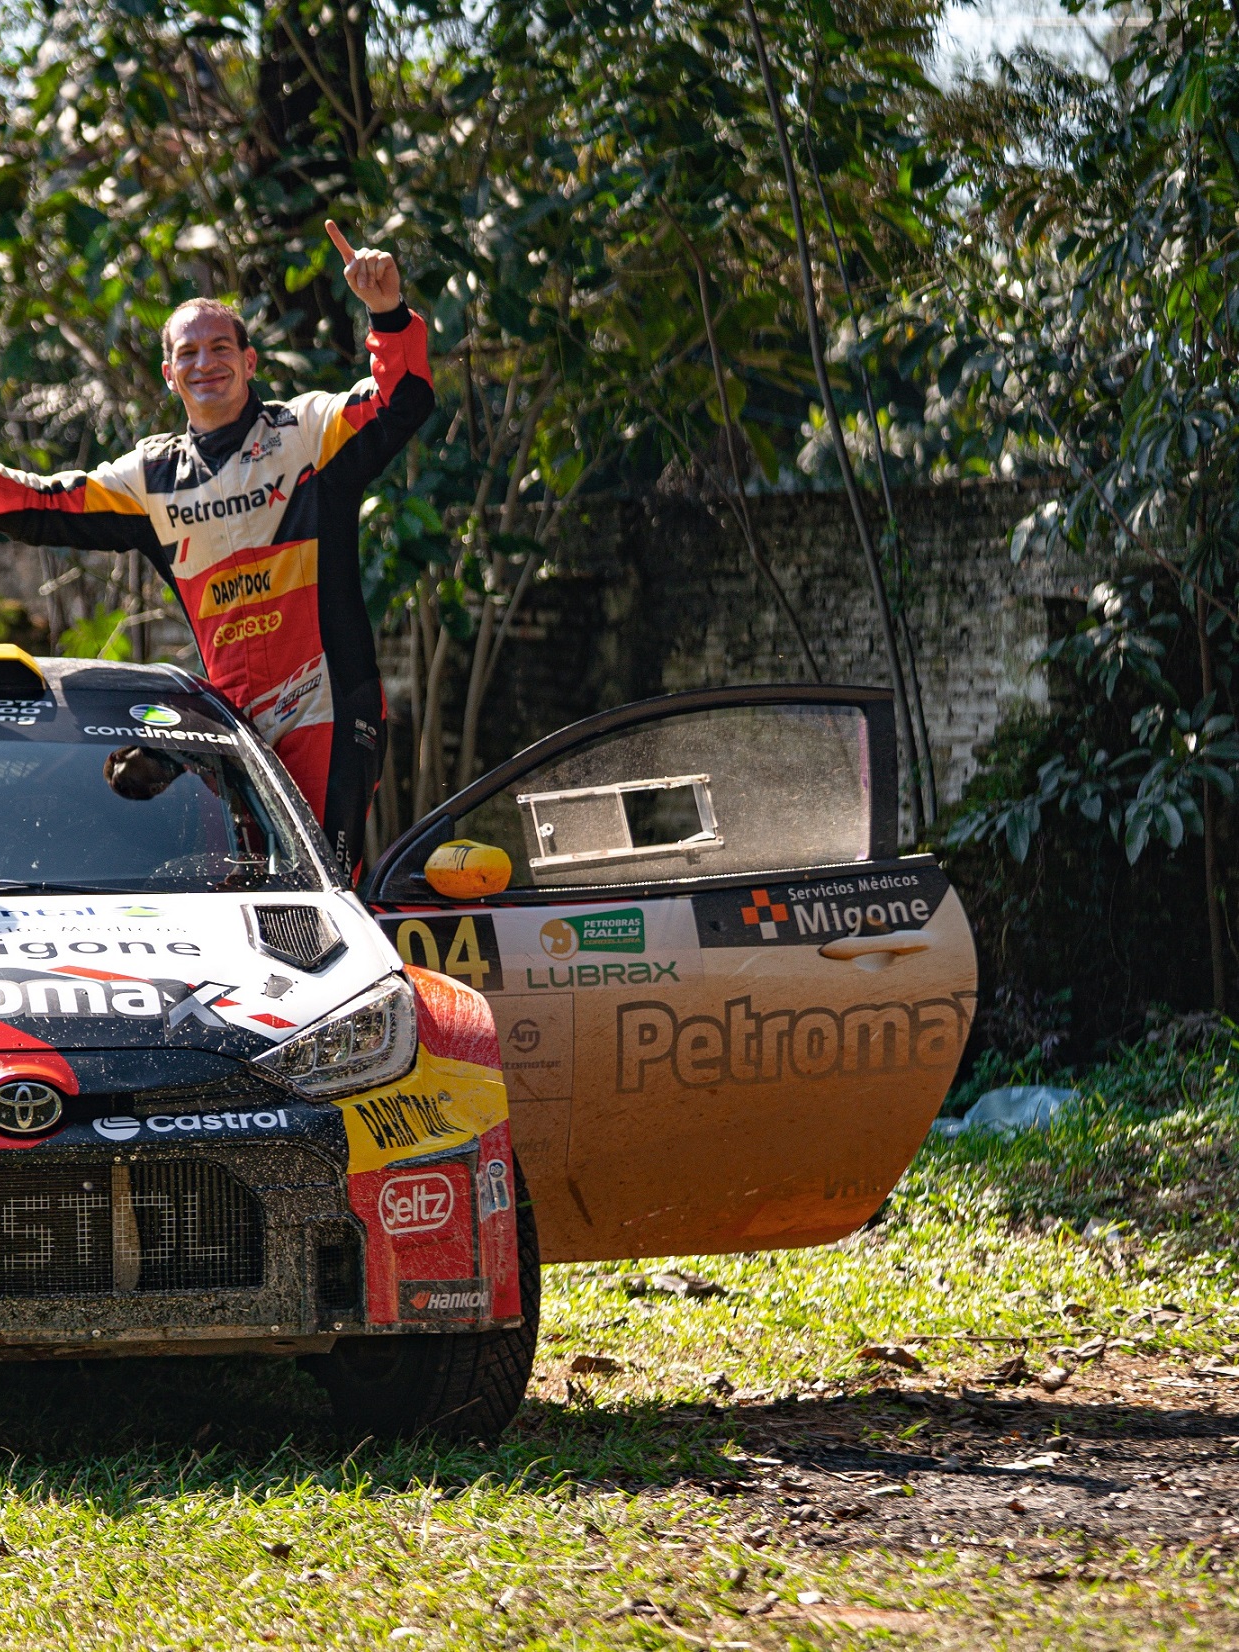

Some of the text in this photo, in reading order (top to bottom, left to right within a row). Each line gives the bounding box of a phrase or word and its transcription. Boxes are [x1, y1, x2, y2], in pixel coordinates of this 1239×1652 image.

[245, 569, 271, 595] DOG
[83, 725, 239, 746] continental
[787, 874, 920, 901] Servicios Médicos
[584, 918, 641, 928] PETROBRAS
[793, 898, 930, 937] Migone
[583, 927, 641, 938] RALLY
[396, 915, 490, 988] 04
[146, 1109, 287, 1133] Castrol
[352, 1094, 419, 1150] DARK
[384, 1184, 447, 1226] Seltz
